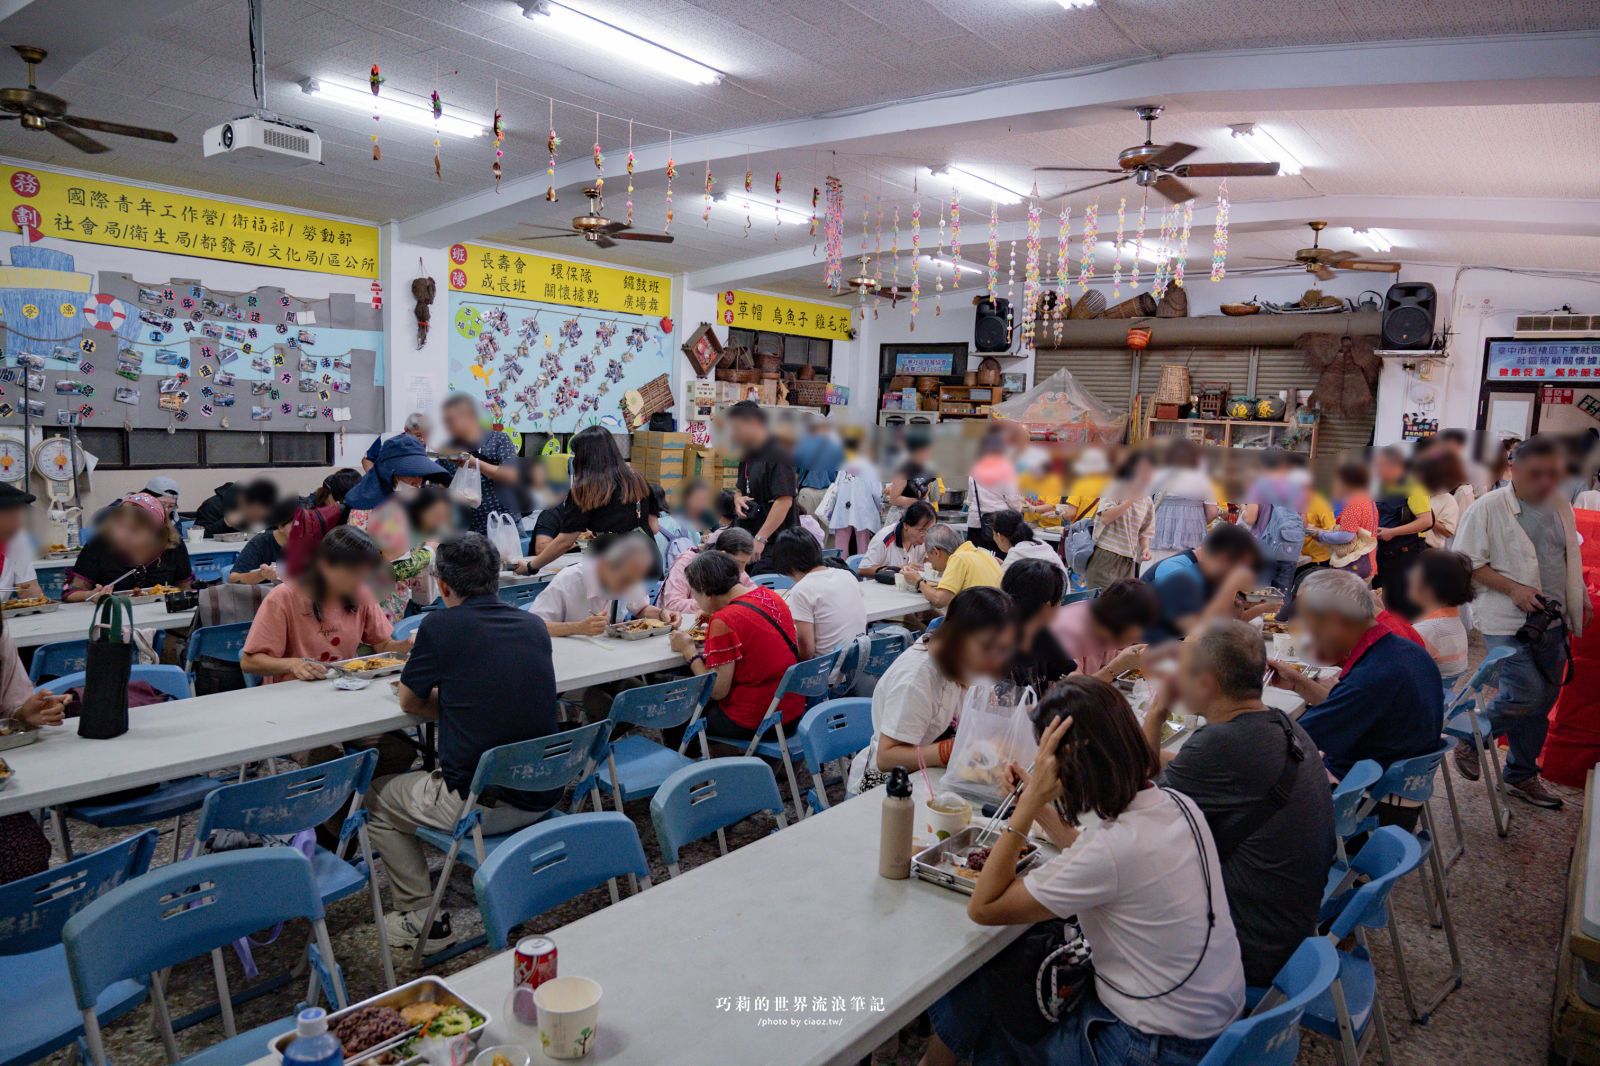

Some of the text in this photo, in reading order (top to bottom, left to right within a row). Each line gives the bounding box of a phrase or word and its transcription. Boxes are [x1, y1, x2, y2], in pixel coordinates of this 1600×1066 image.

[14, 172, 38, 194] 務
[15, 206, 37, 229] 劃
[451, 246, 465, 262] 班
[450, 271, 465, 287] 隊
[480, 252, 526, 274] 長壽會
[551, 263, 592, 284] 環保隊
[481, 272, 660, 312] 成長班 關懷據點 廣場舞
[737, 301, 849, 334] 草帽 烏魚子 雞毛花
[1517, 356, 1600, 366] 社區照顧關懷據
